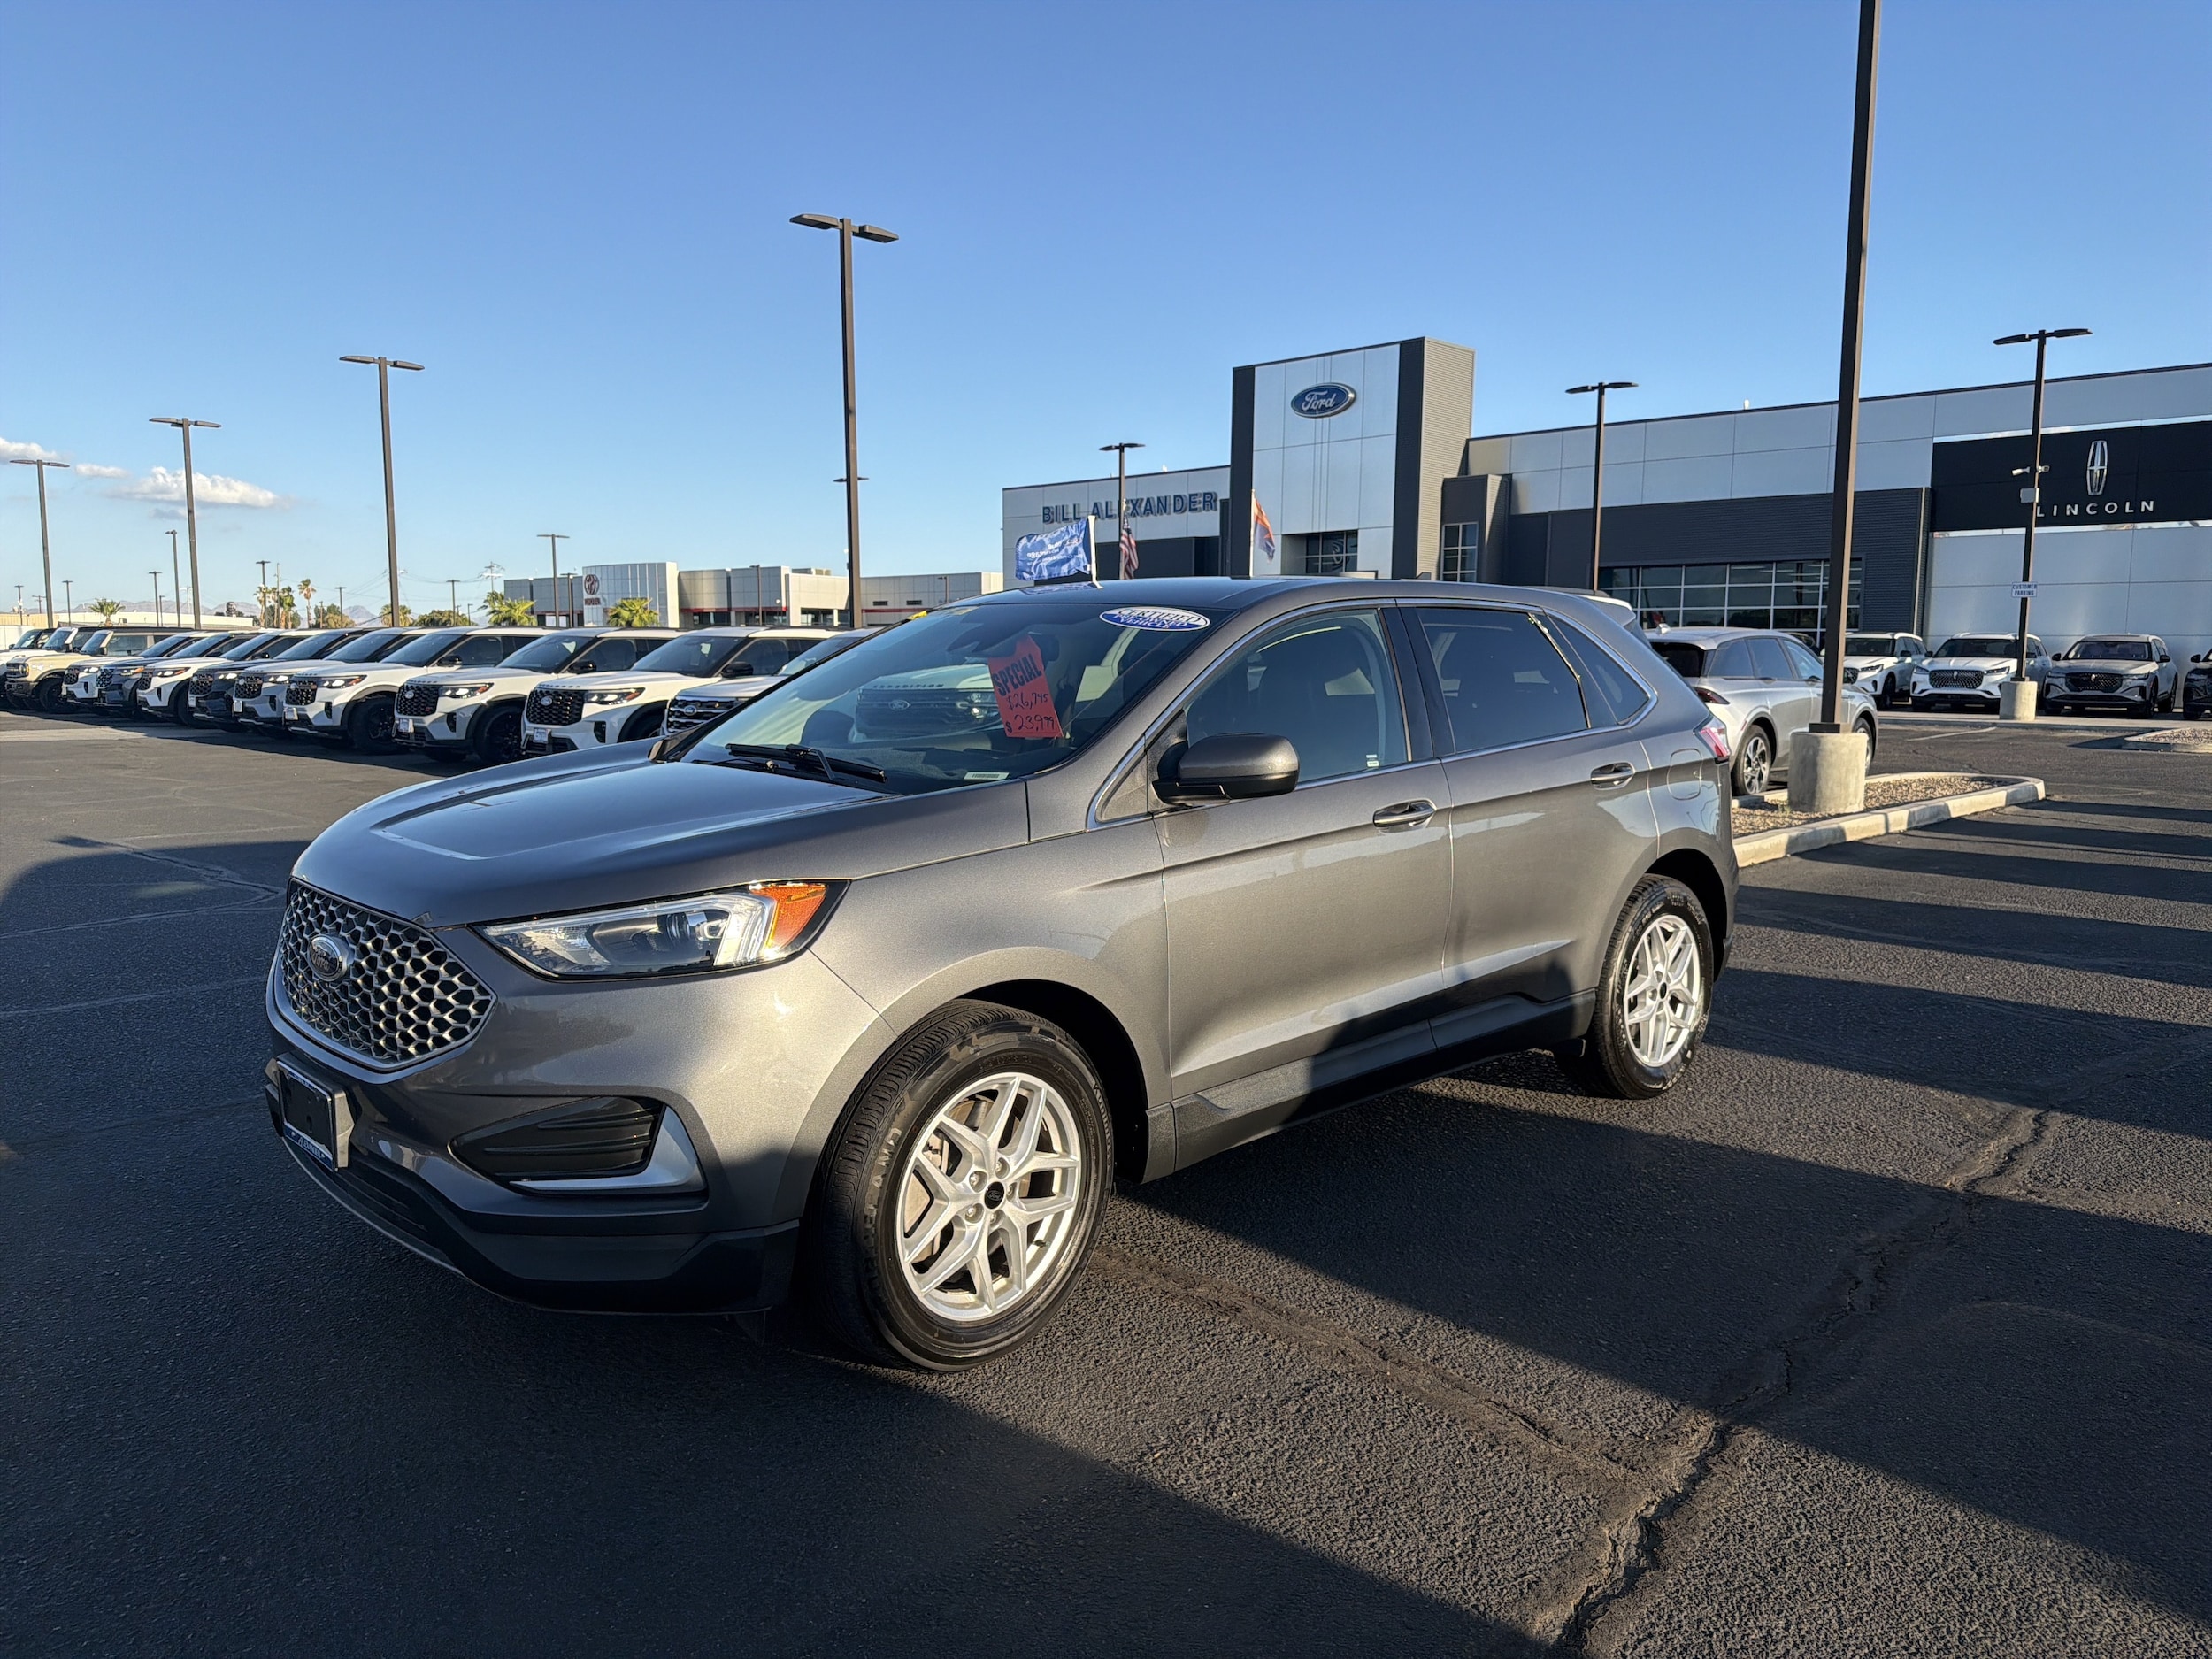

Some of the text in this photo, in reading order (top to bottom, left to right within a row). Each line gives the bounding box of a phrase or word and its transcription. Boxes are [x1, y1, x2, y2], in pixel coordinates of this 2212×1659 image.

[1042, 491, 1217, 524] BILL ALXANDER
[2036, 500, 2154, 518] LINCOLN
[1118, 608, 1201, 623] CERTIFIED
[992, 653, 1042, 697] SPECIAL
